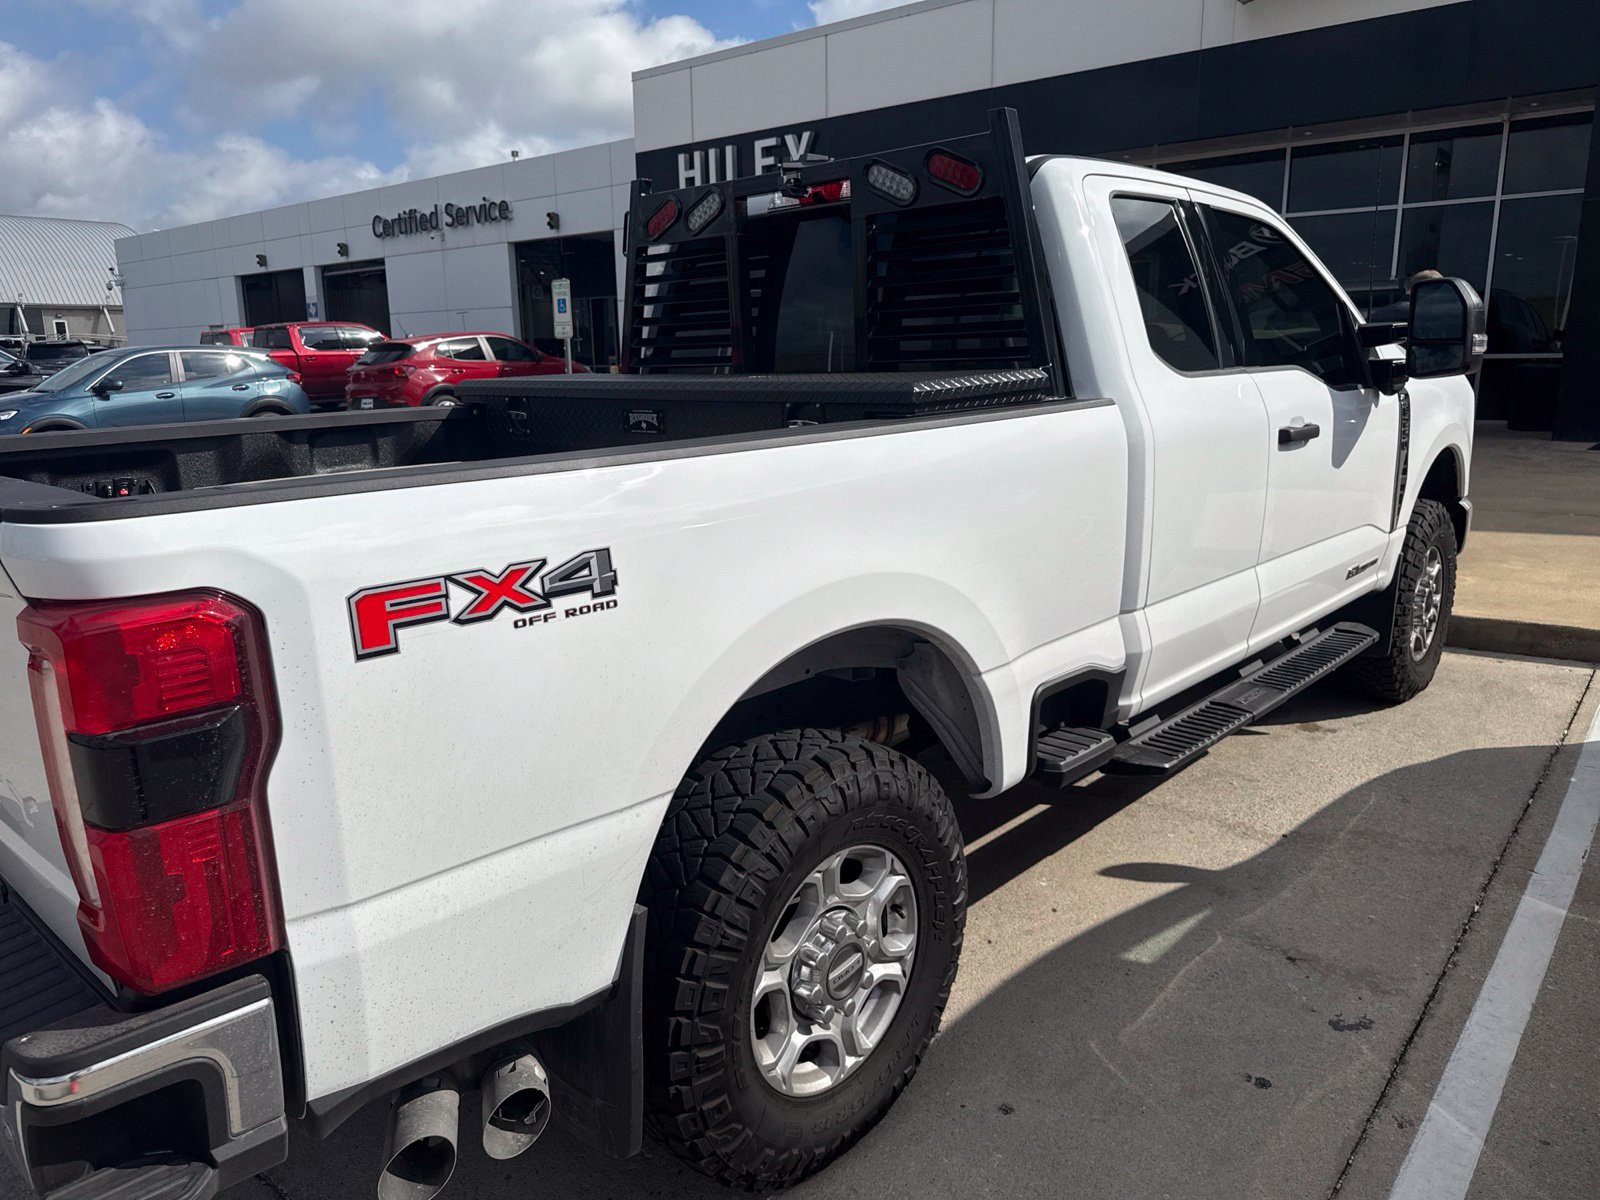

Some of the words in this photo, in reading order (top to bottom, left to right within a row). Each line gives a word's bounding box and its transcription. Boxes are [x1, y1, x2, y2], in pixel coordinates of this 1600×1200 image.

[372, 203, 441, 239] Certified
[444, 197, 512, 229] Service
[345, 546, 618, 663] FX4
[513, 611, 557, 629] OFF
[564, 599, 619, 619] ROAD
